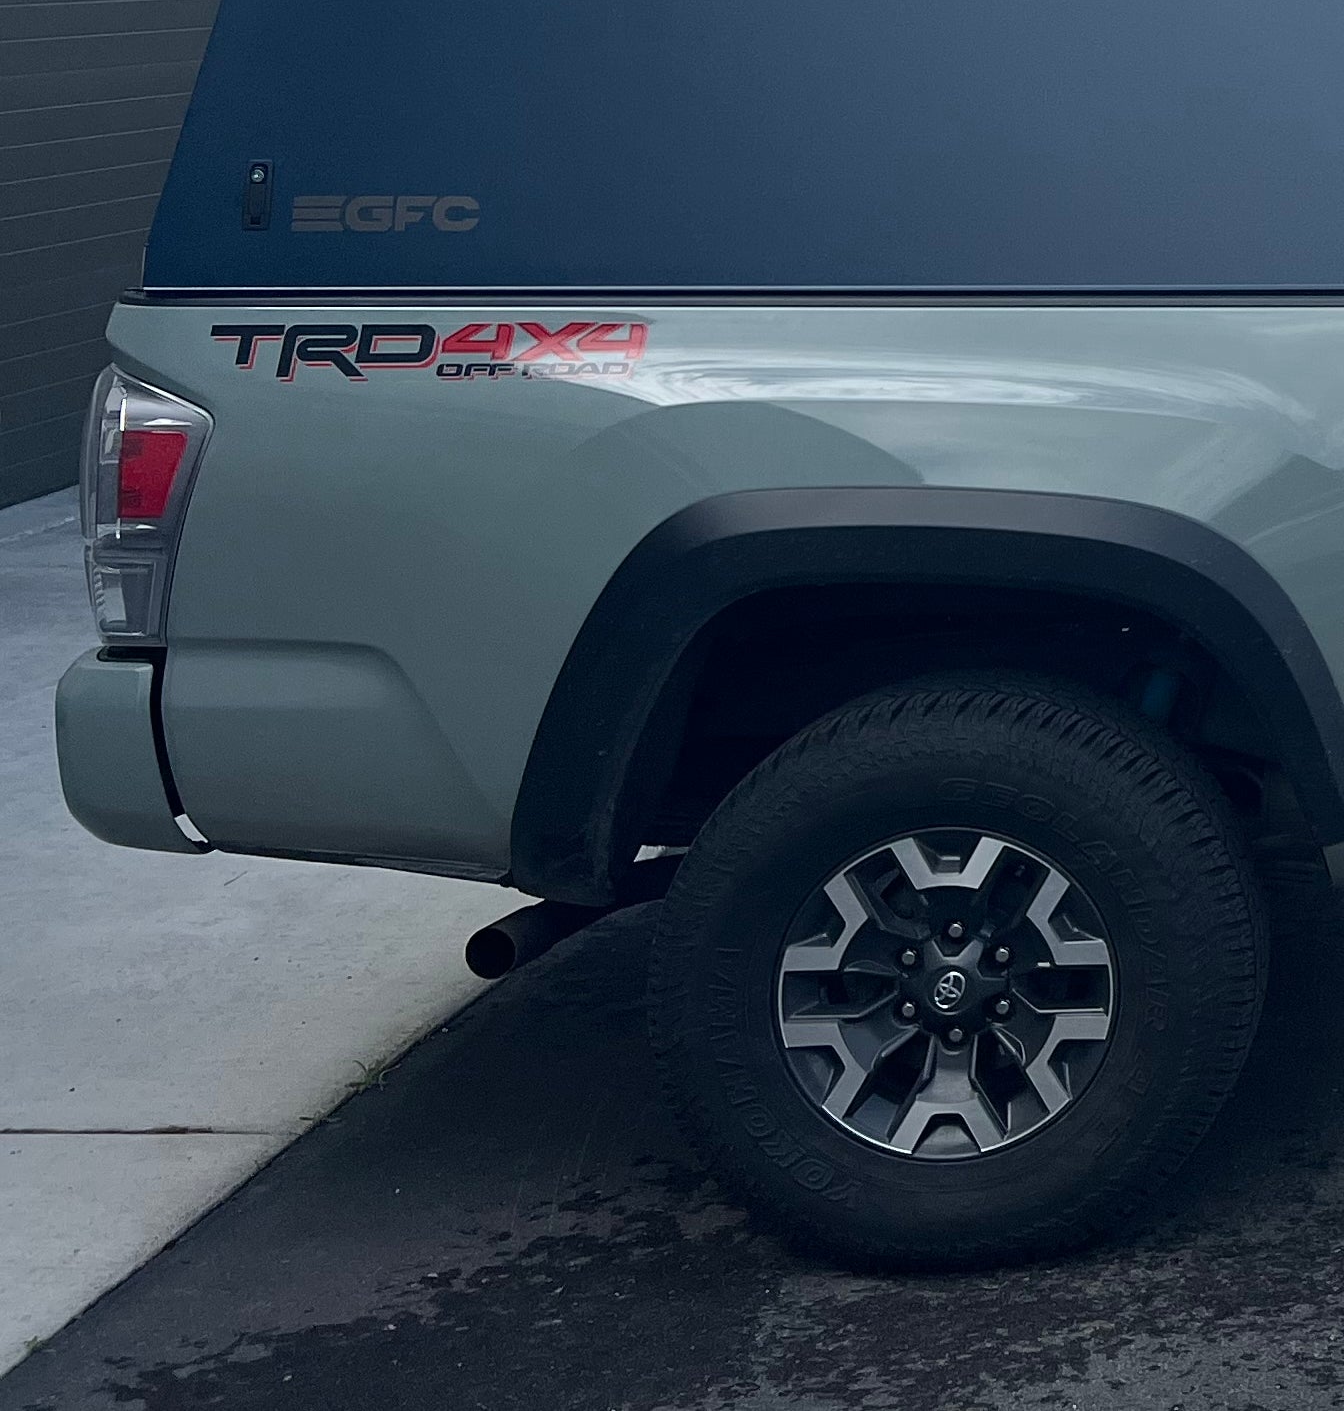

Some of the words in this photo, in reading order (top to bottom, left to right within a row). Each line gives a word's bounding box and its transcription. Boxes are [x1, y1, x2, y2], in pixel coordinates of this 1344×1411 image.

[210, 323, 440, 383] TRD
[438, 321, 650, 363] 4X4
[434, 361, 516, 382] OFF
[519, 361, 636, 381] ROAD
